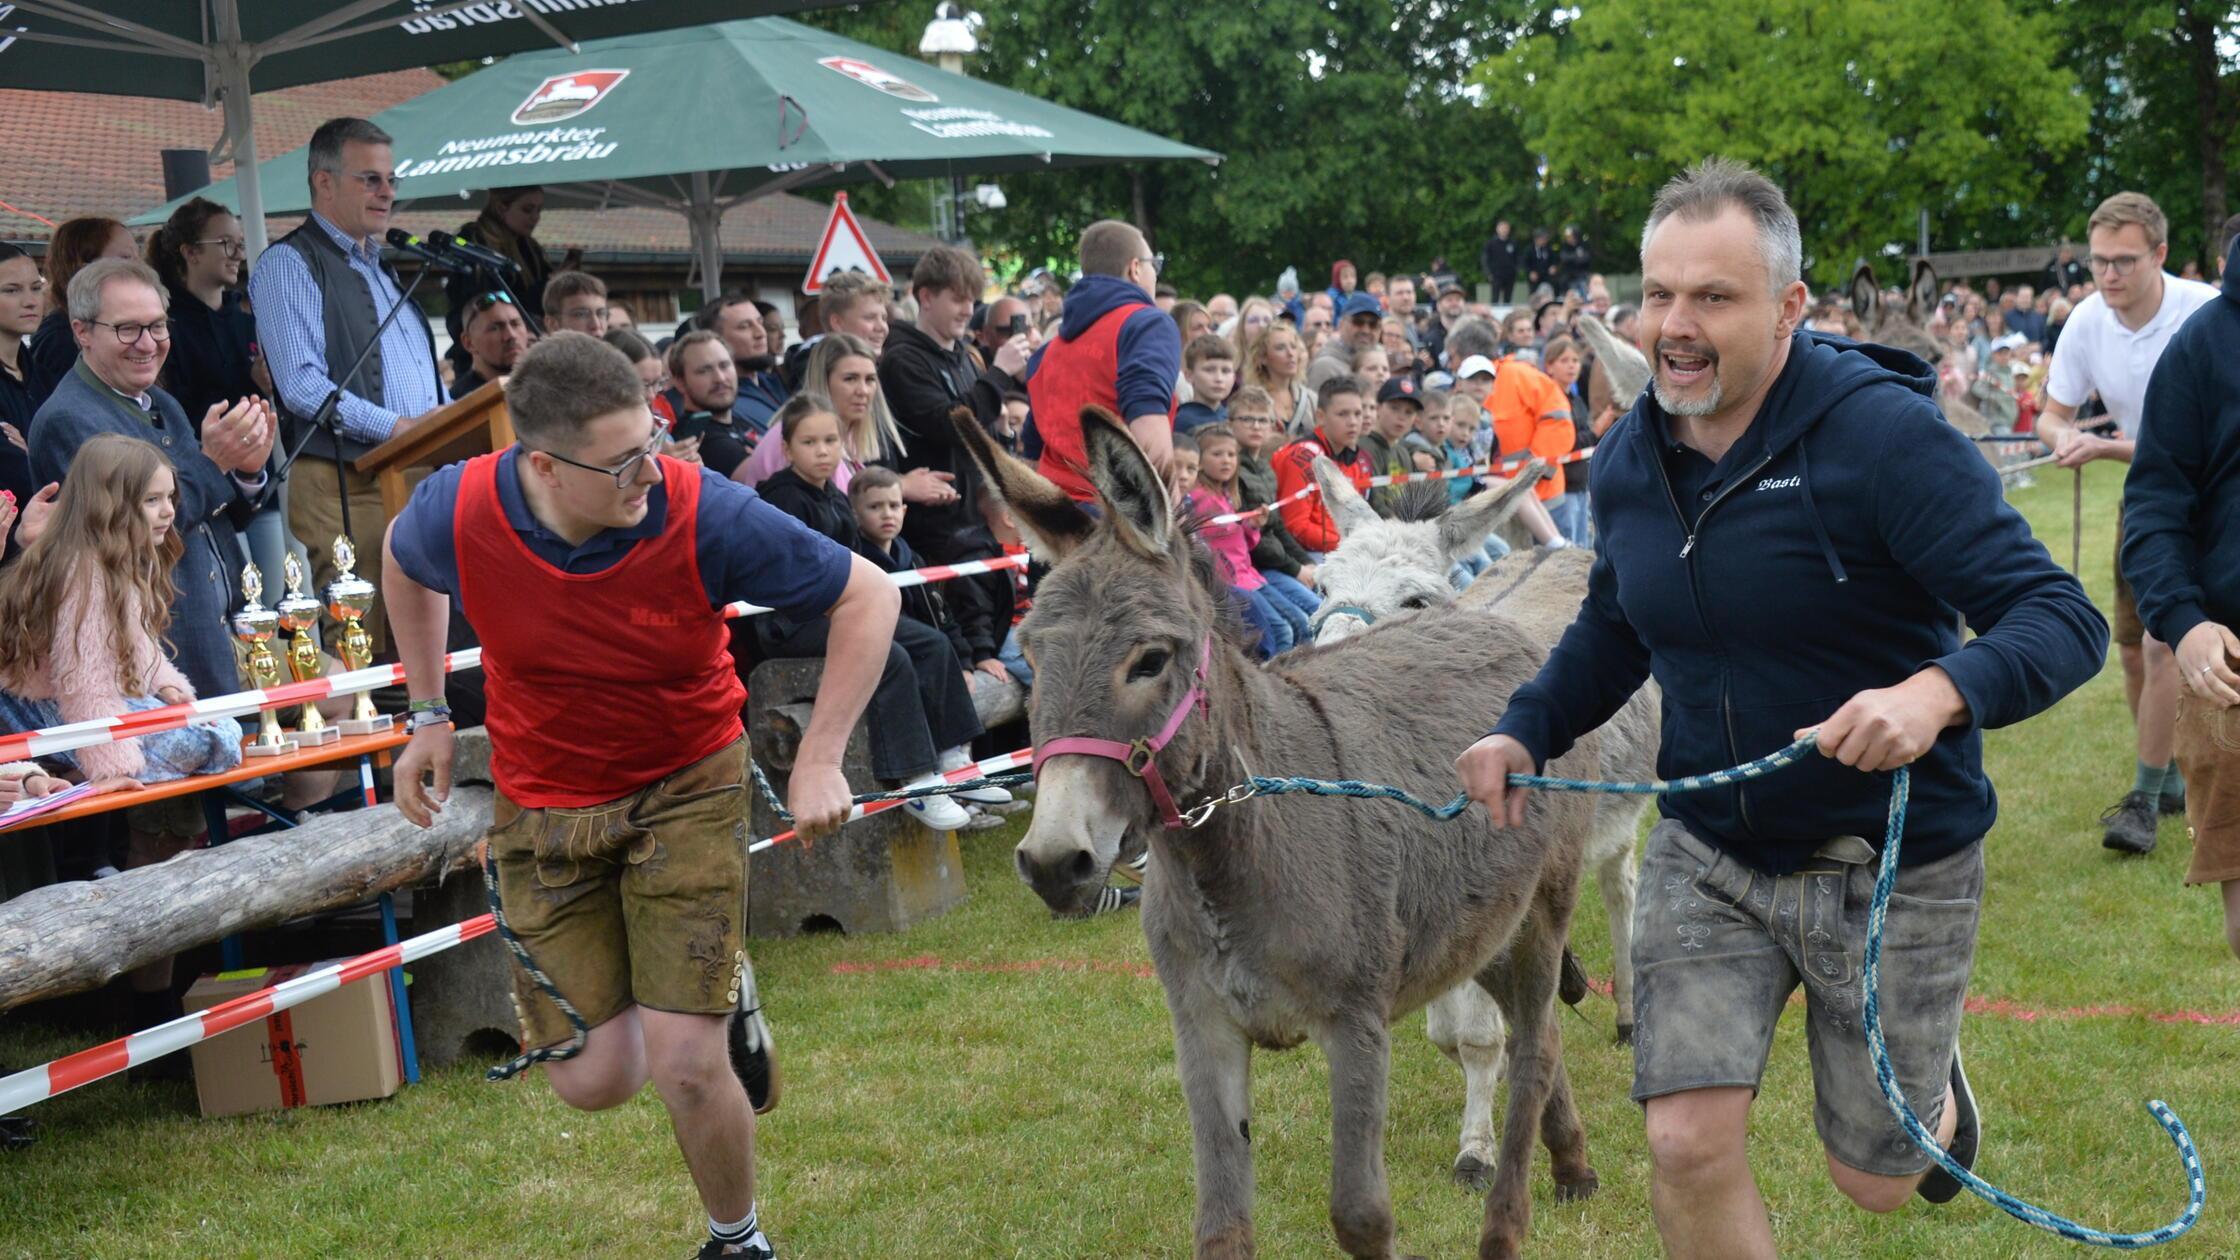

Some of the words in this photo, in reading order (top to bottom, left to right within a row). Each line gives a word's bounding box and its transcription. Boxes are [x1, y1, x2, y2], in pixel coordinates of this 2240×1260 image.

[437, 127, 606, 155] Neumarkter
[394, 141, 618, 178] Lammsbräu
[1755, 475, 1801, 491] Basti
